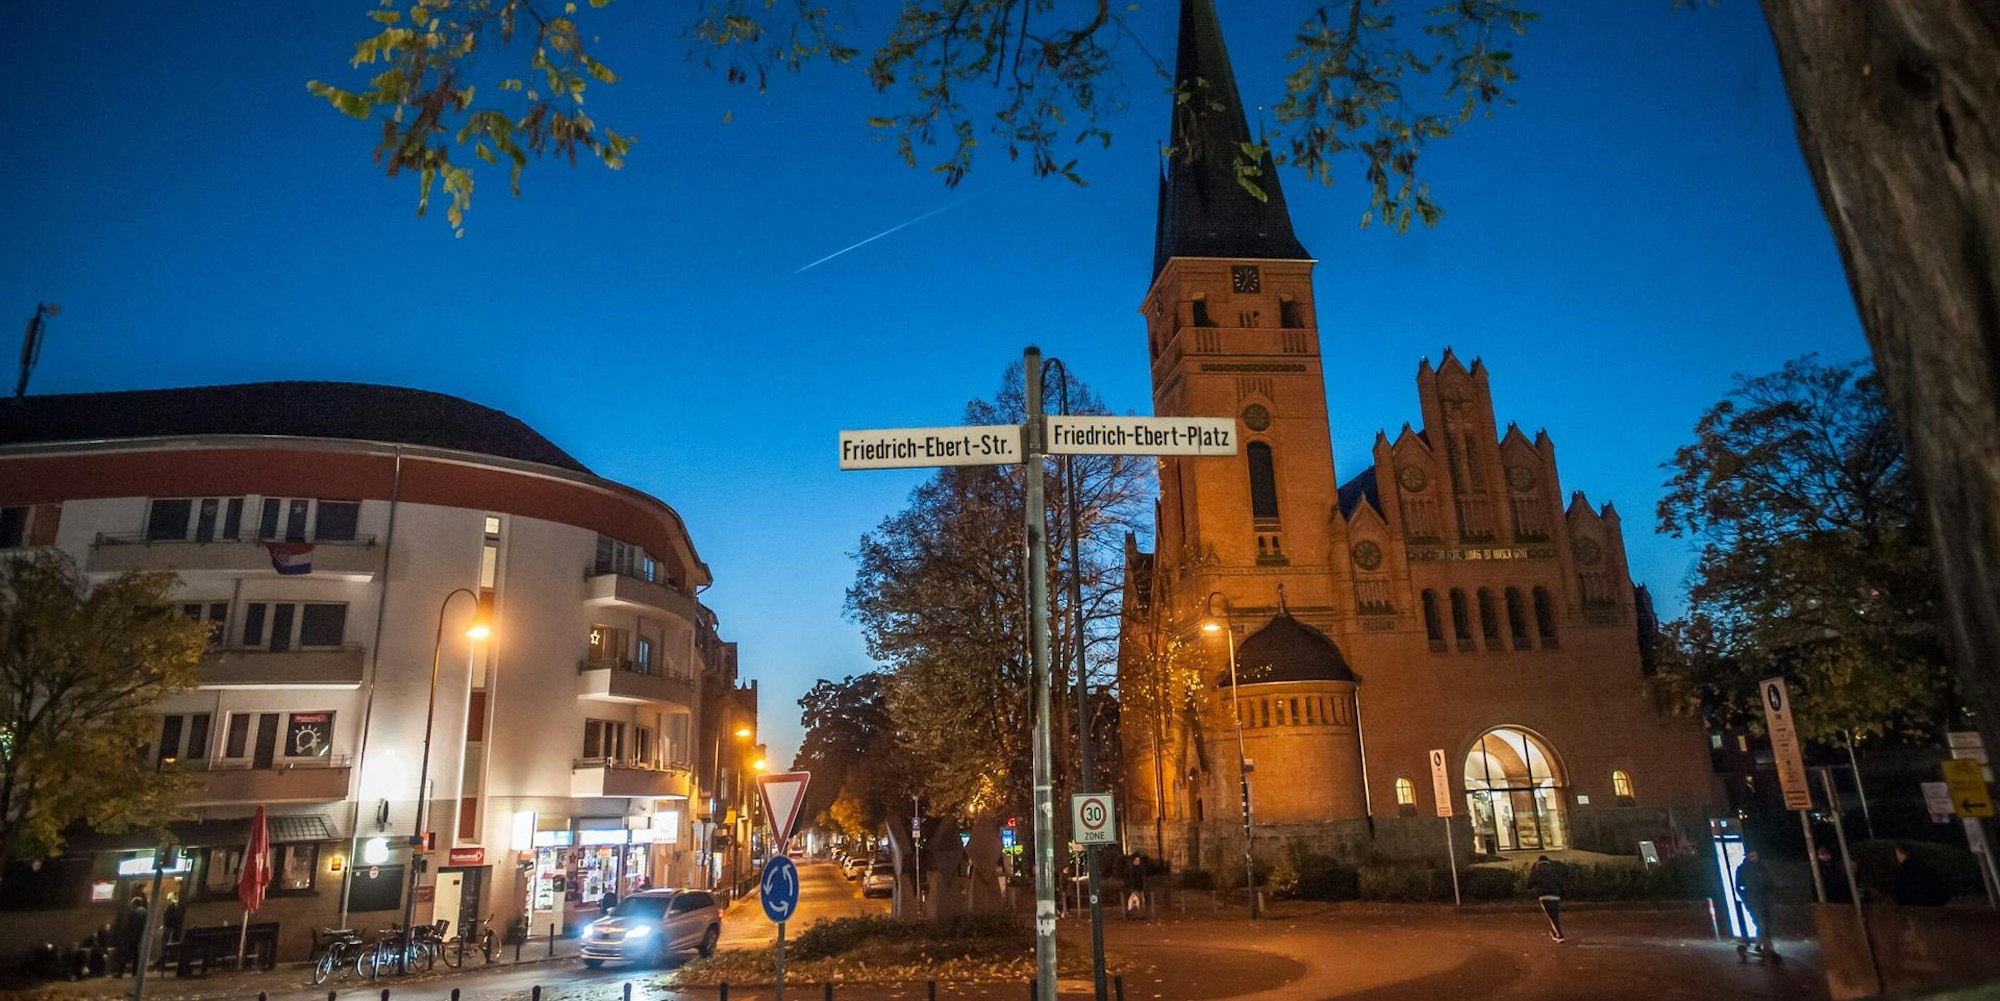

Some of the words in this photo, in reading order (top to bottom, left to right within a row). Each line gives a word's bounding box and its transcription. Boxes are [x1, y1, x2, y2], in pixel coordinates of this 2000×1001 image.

[1054, 425, 1230, 447] Friedrich-Ebert-Platz
[843, 434, 1013, 460] Friedrich-Ebert-Str.
[1086, 807, 1101, 821] 30
[1084, 831, 1106, 841] ZONE
